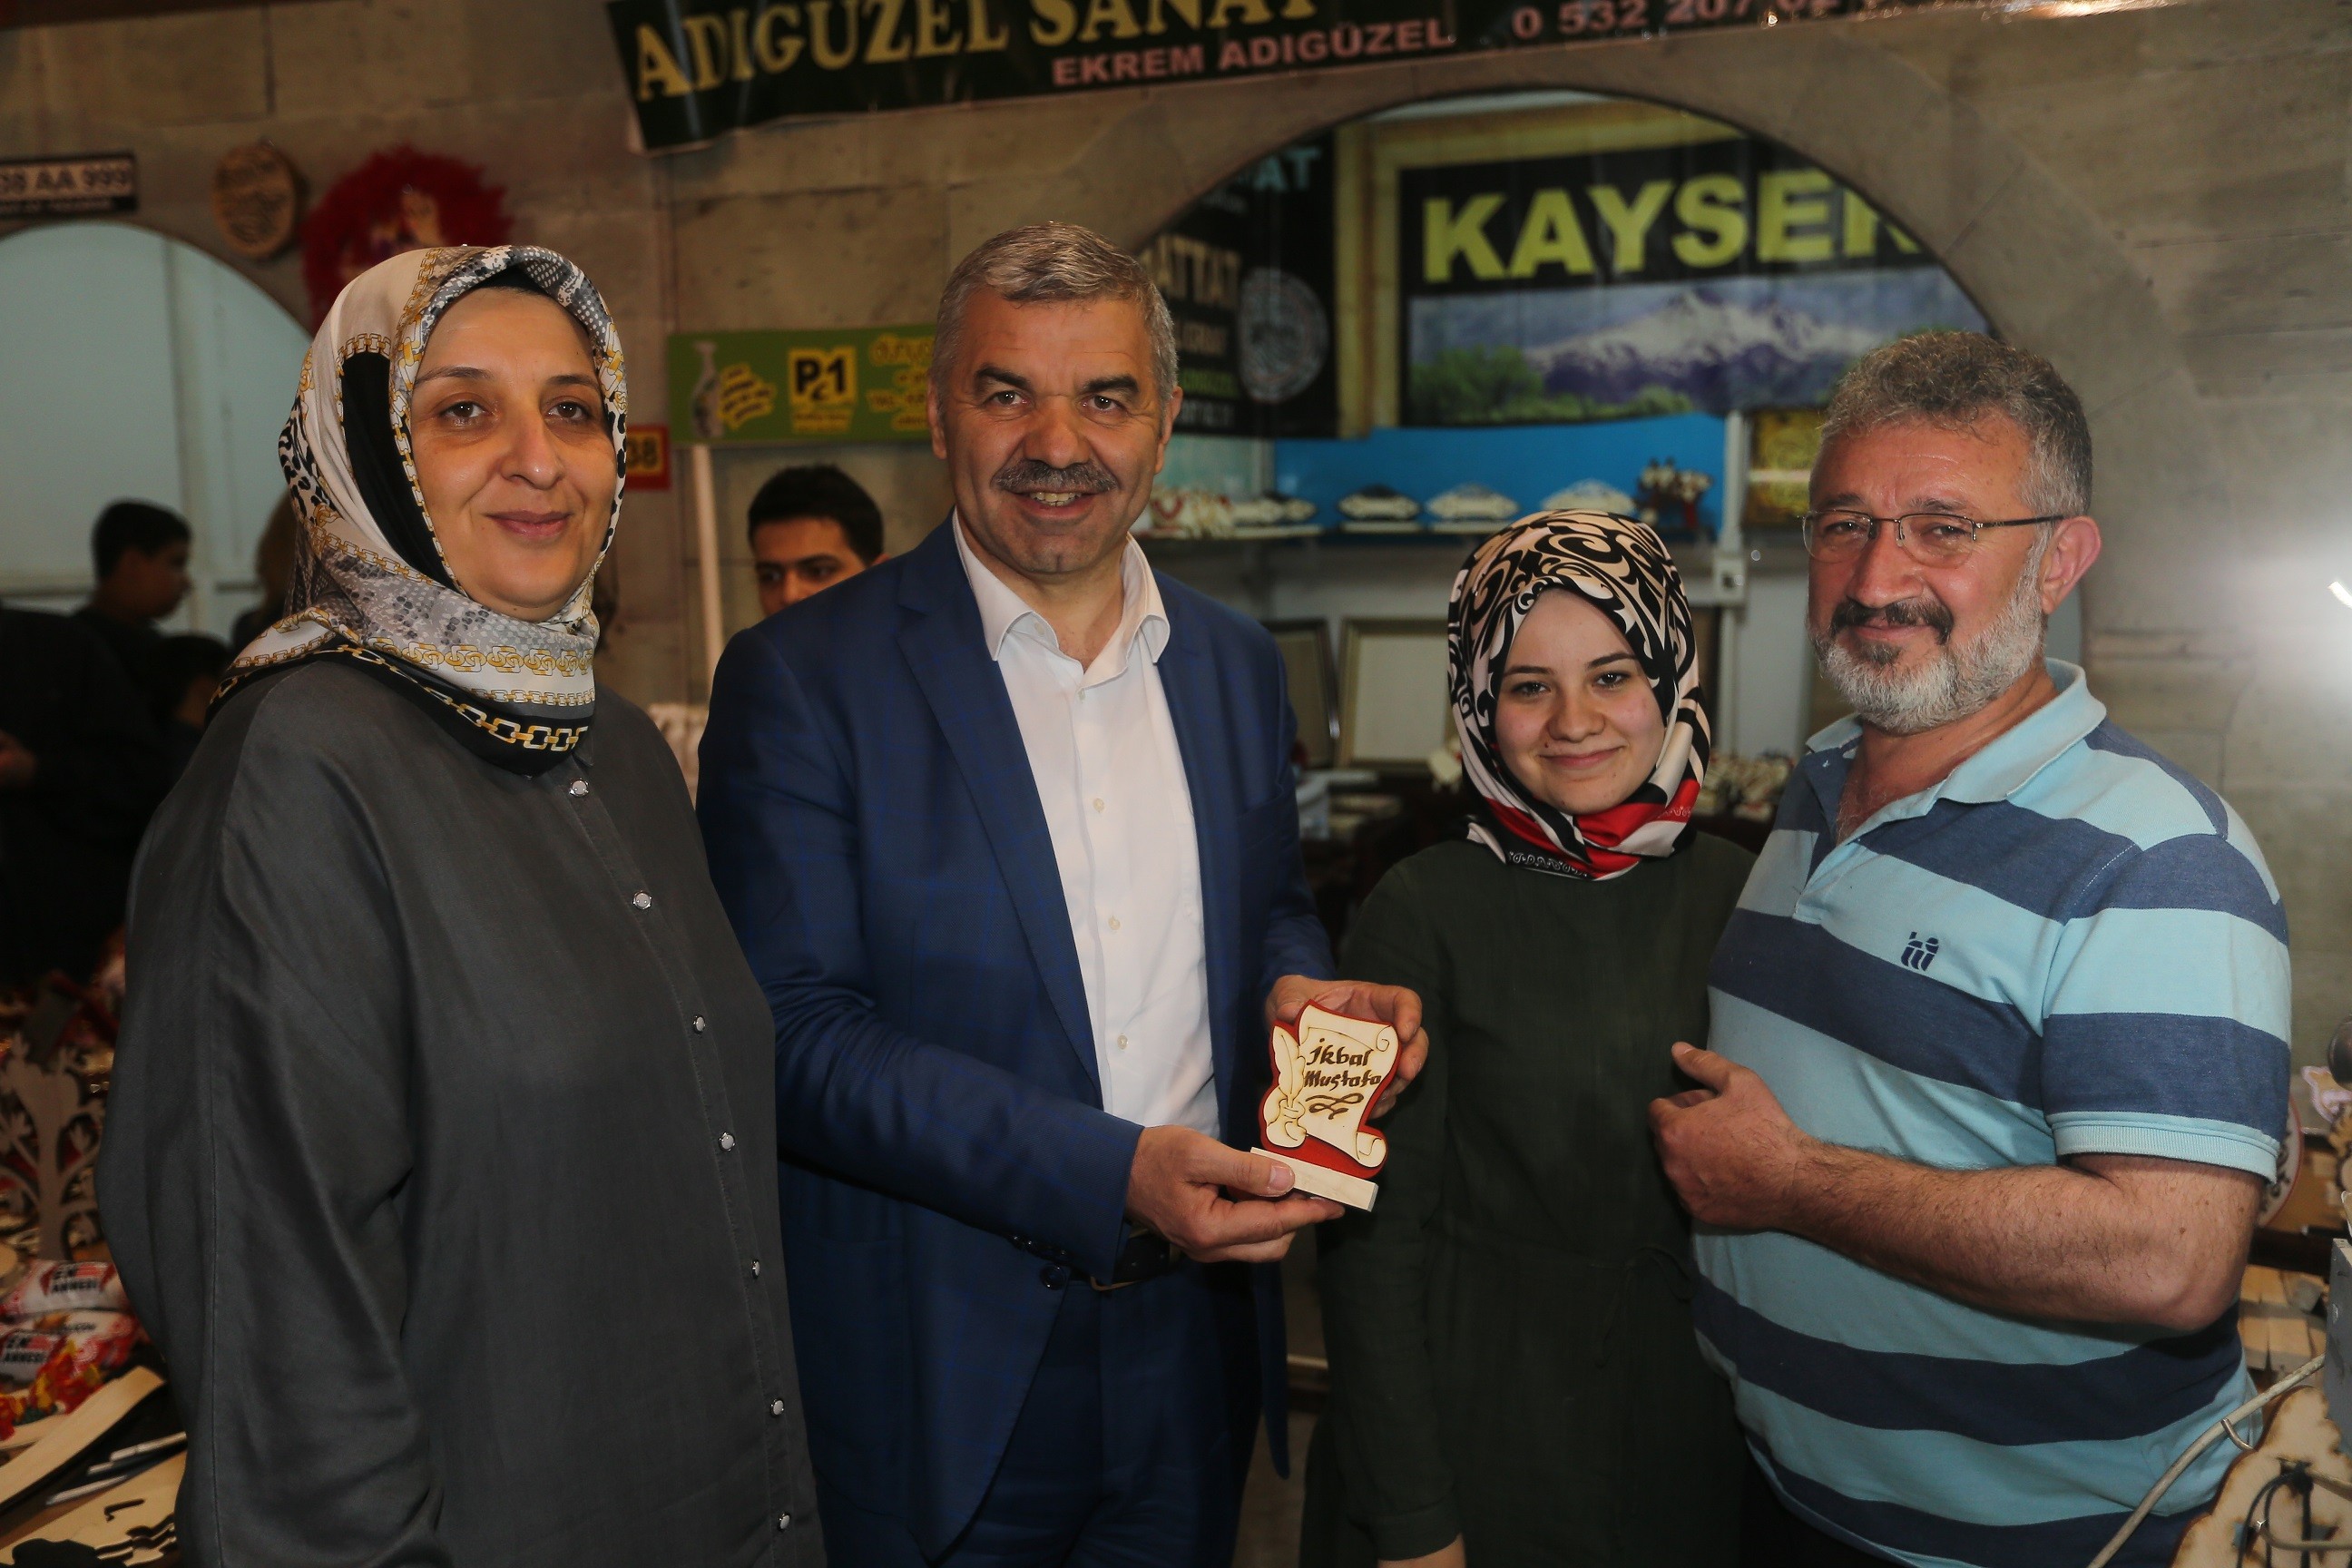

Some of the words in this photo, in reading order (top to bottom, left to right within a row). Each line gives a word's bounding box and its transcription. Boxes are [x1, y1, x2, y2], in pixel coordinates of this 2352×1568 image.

[1051, 45, 1205, 86] EKREM
[1217, 18, 1457, 70] ADIGÜZEL
[1556, 0, 1649, 35] 532
